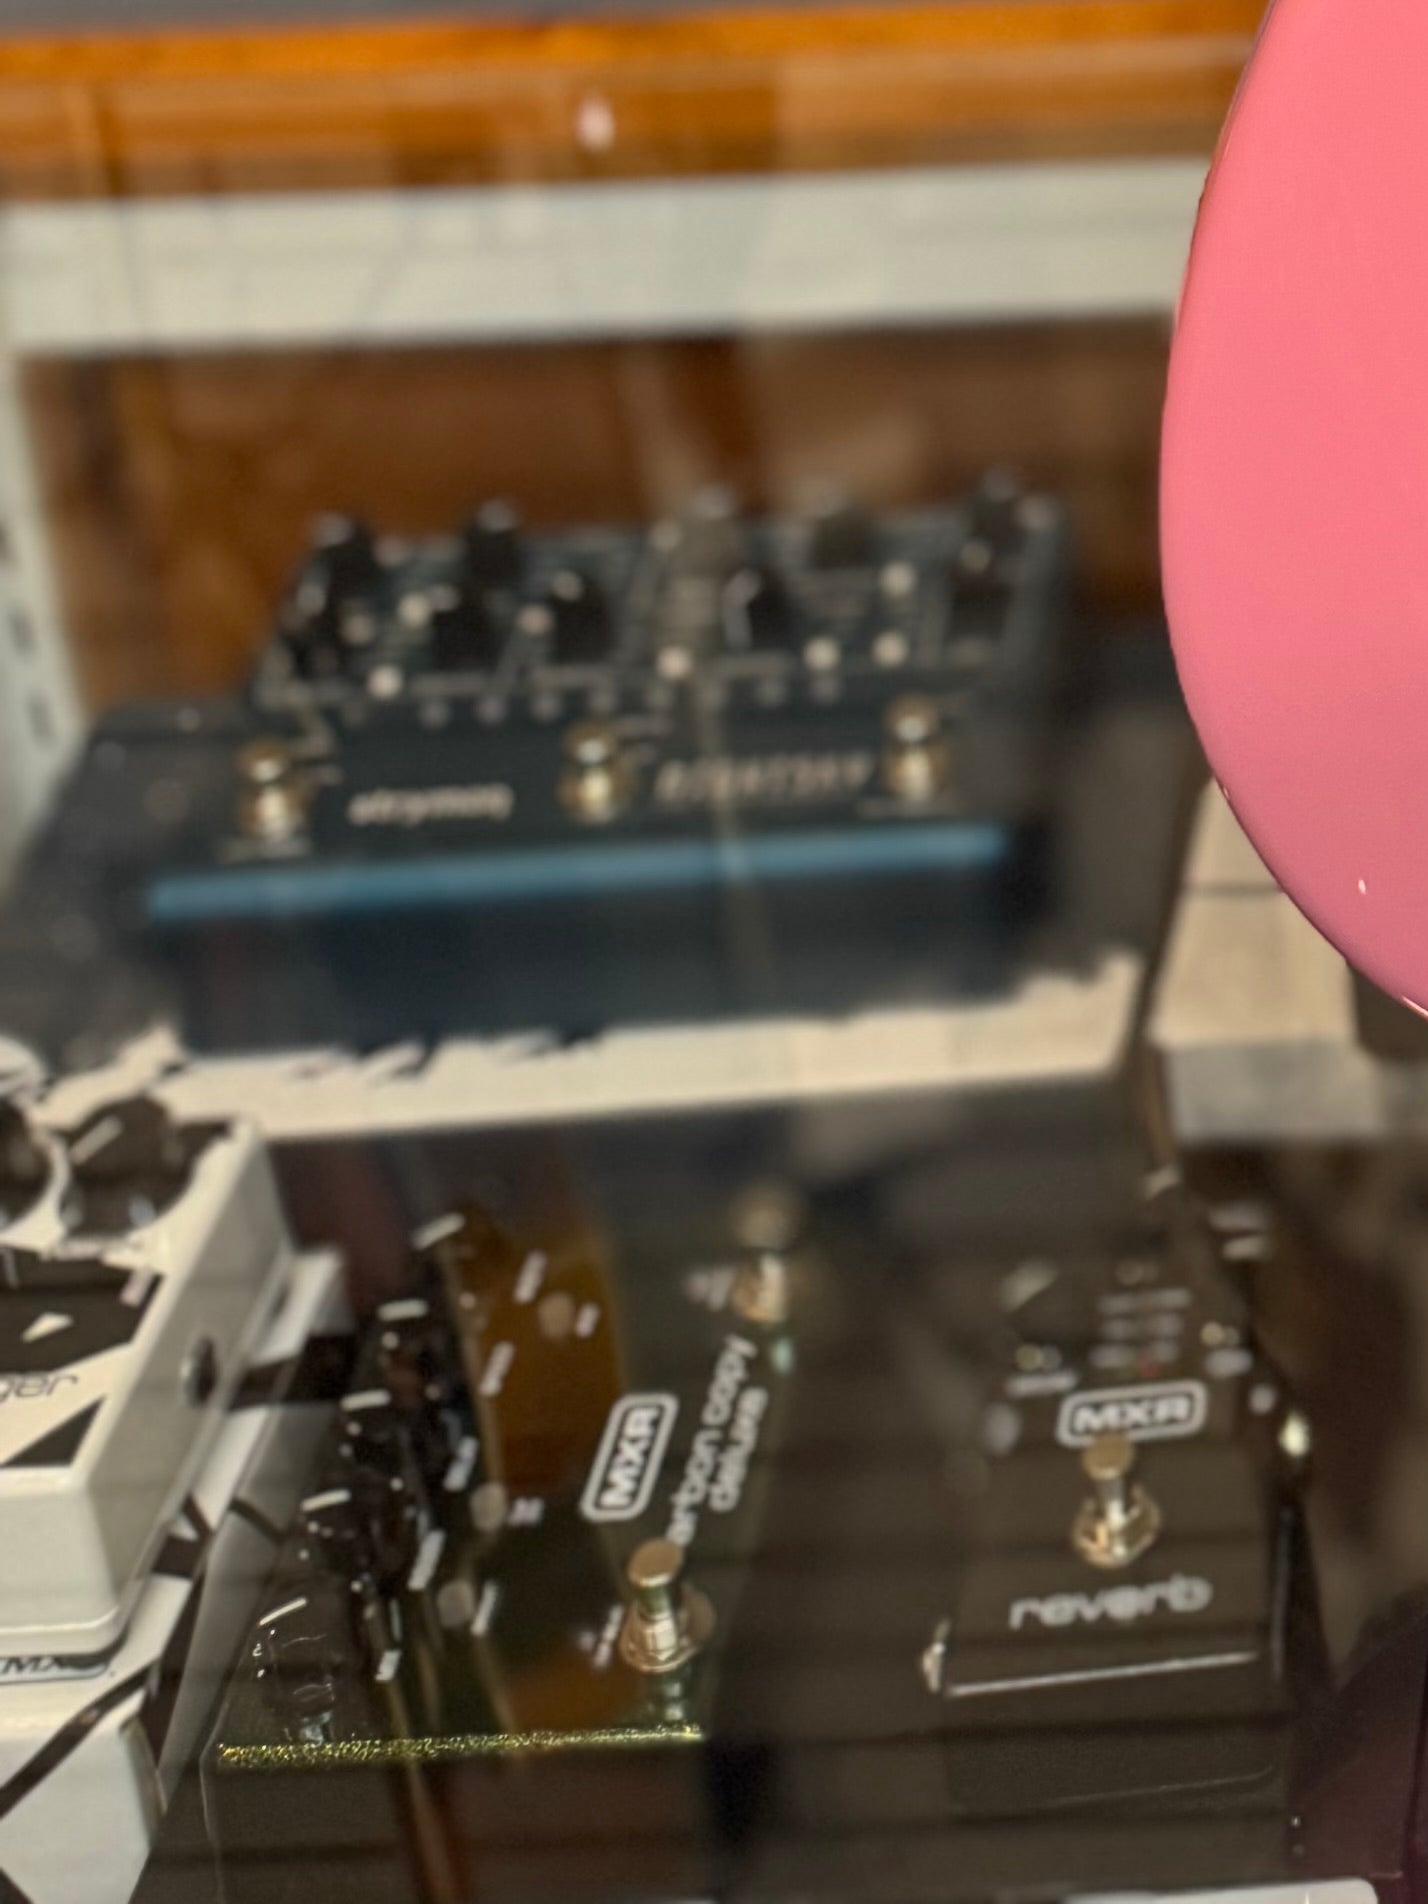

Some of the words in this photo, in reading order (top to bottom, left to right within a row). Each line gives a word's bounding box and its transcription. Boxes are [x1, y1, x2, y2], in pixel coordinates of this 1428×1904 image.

[600, 1406, 659, 1507] MXR
[667, 1429, 724, 1548] arbon
[702, 1334, 757, 1426] copy
[708, 1388, 769, 1513] deluxe
[1073, 1394, 1191, 1433] MXR
[1009, 1573, 1213, 1630] reverb
